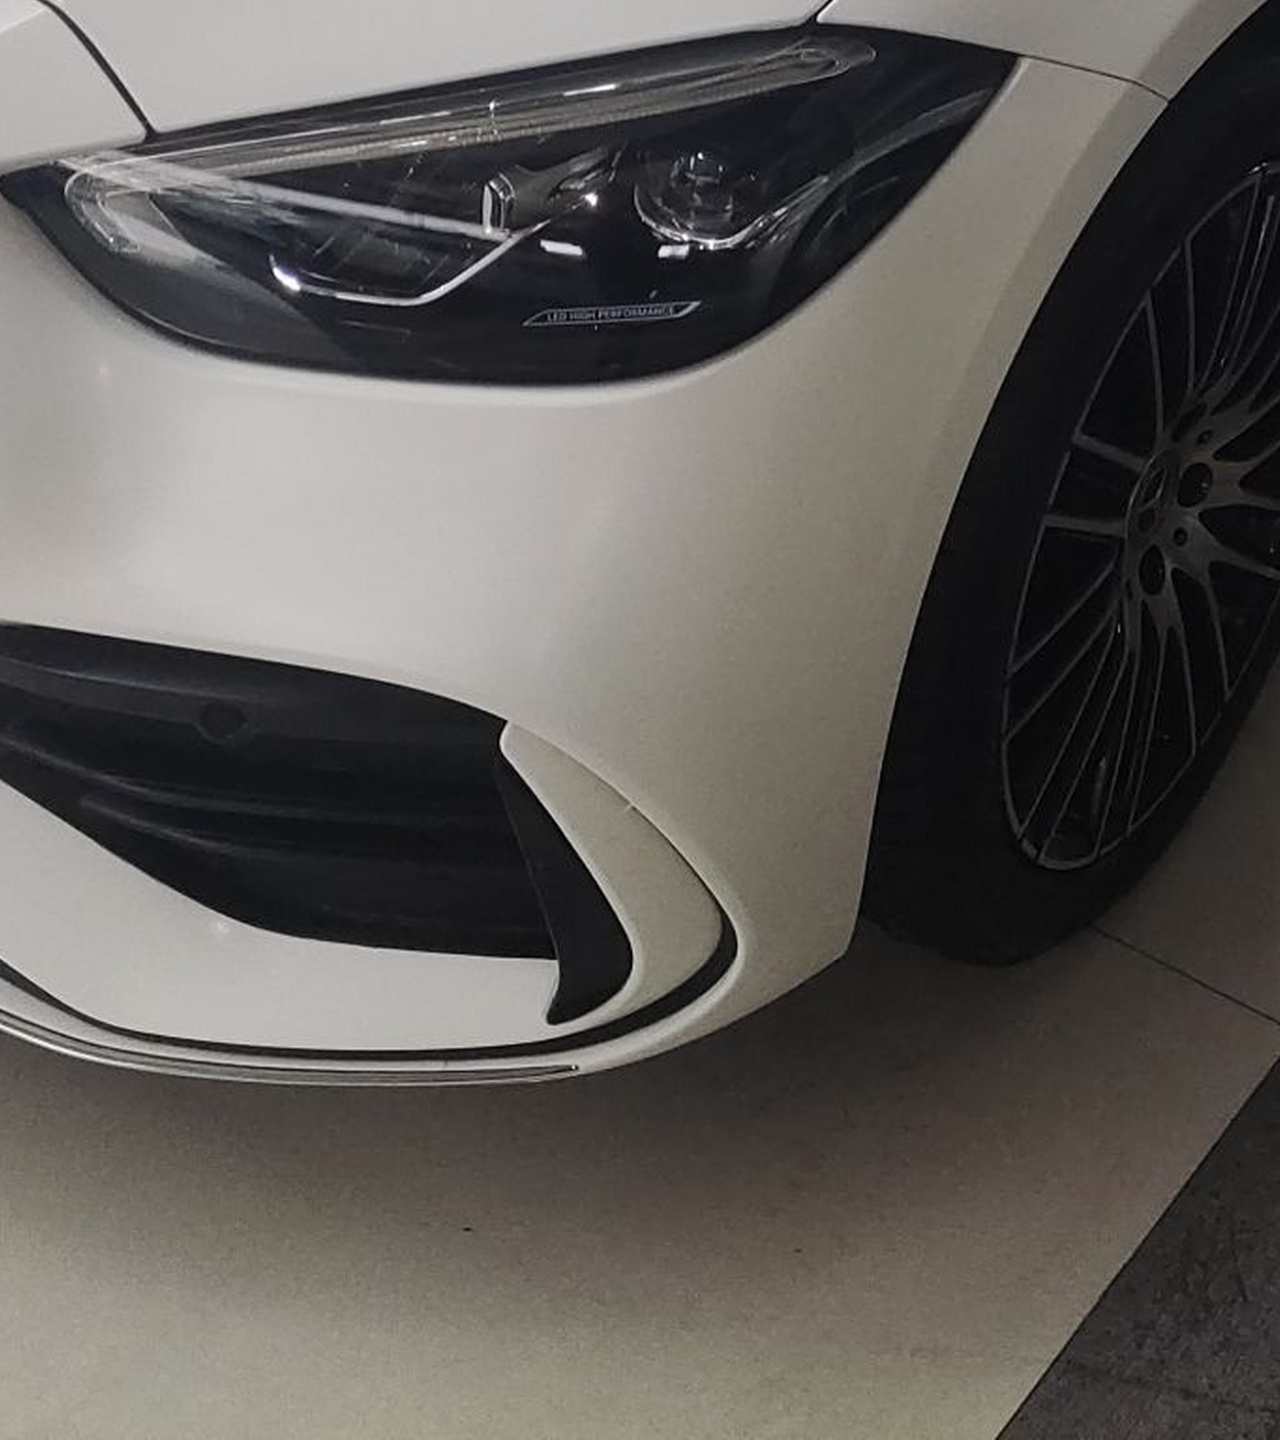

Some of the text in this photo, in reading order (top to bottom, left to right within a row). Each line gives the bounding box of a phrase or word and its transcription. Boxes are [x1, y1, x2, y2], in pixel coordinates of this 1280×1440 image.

[547, 305, 674, 323] LED HIGH PERFORMANCE
